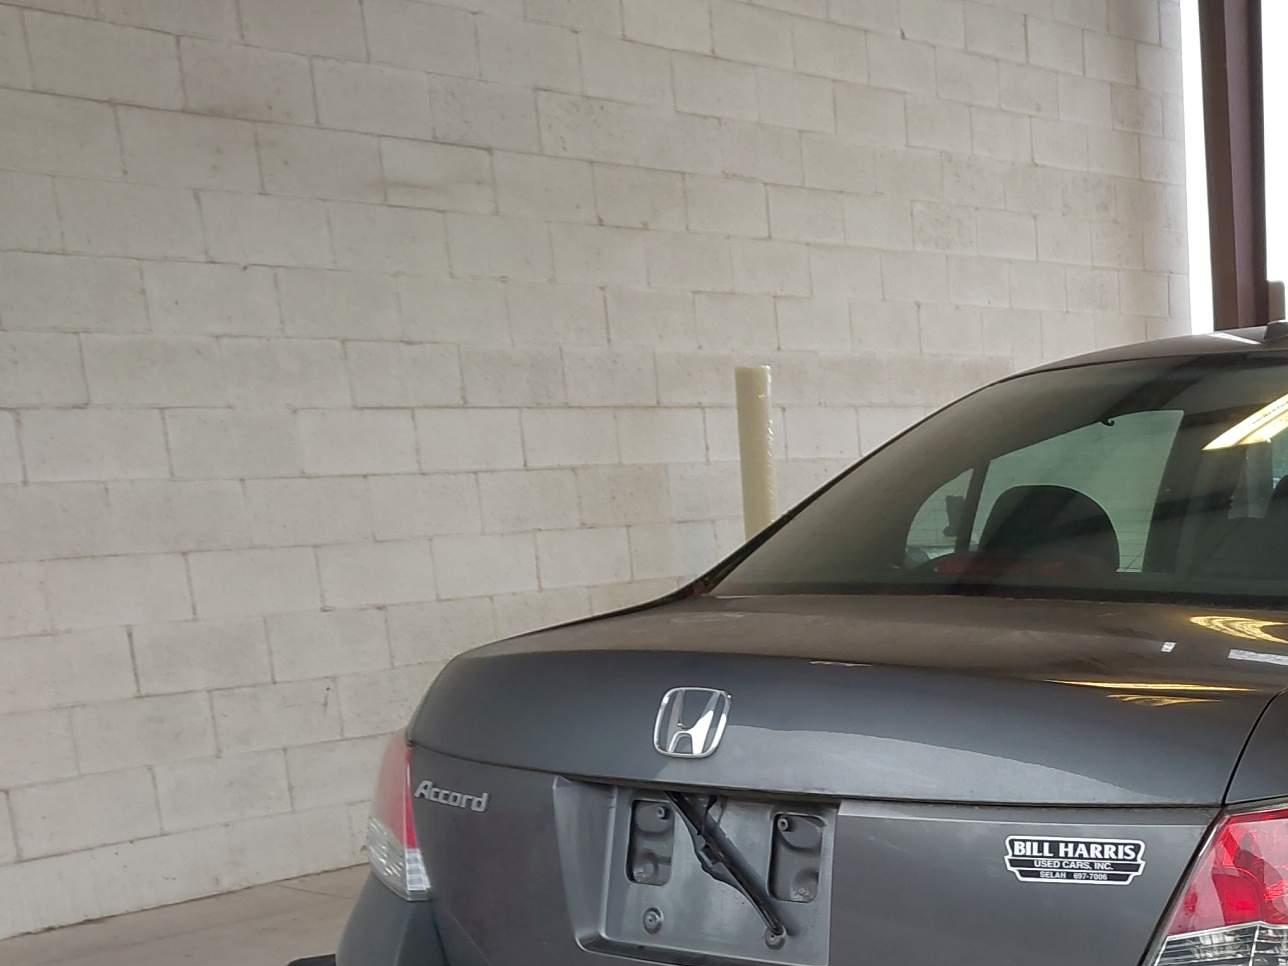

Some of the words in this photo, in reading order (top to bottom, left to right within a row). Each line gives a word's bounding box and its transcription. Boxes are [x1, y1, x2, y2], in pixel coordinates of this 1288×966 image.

[414, 780, 489, 812] Accord
[1013, 841, 1054, 857] BILL
[1058, 843, 1137, 860] HARRIS
[1034, 860, 1061, 868] USED
[1094, 862, 1114, 870] INC.
[1039, 871, 1067, 879] SELAH
